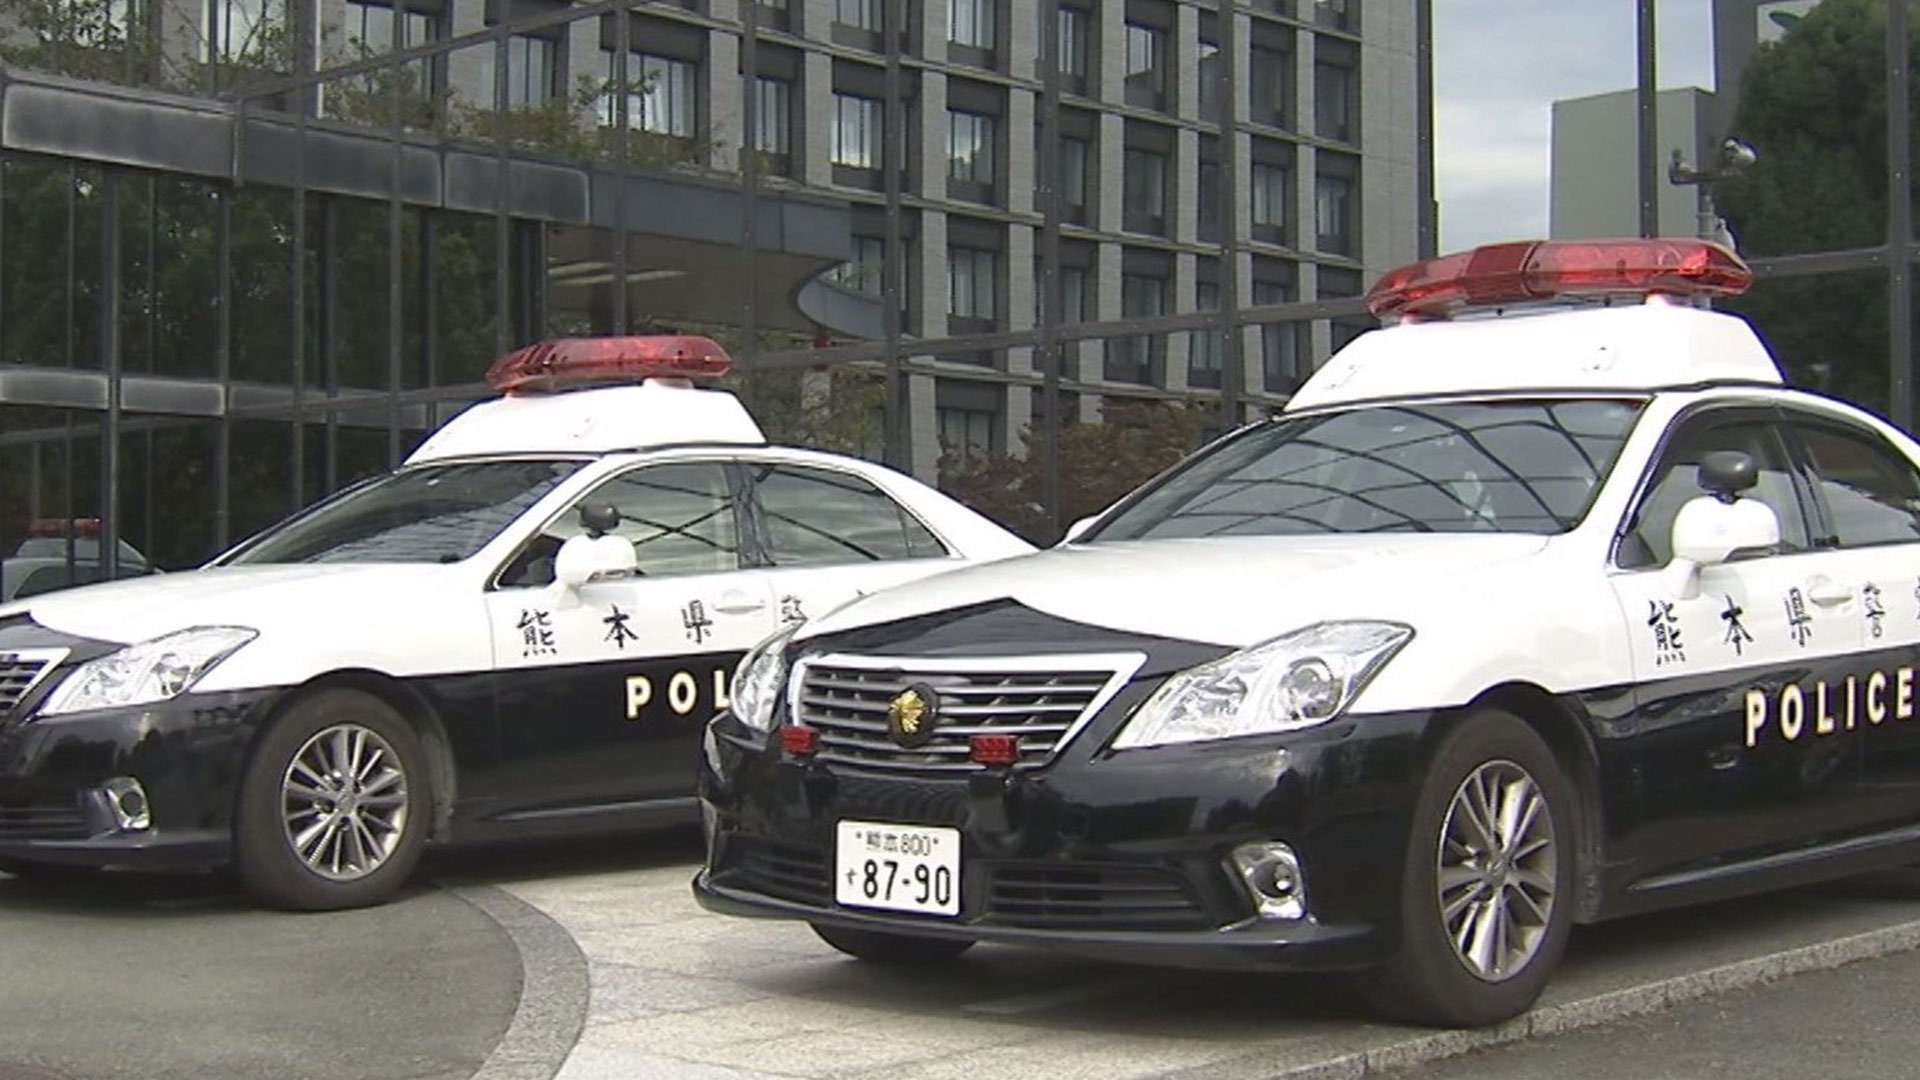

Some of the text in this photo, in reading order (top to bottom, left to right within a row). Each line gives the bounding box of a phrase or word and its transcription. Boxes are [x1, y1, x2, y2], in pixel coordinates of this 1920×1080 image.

[1647, 574, 1920, 667] 熊本県警
[1745, 666, 1914, 748] POLICE
[863, 859, 951, 906] 87-90
